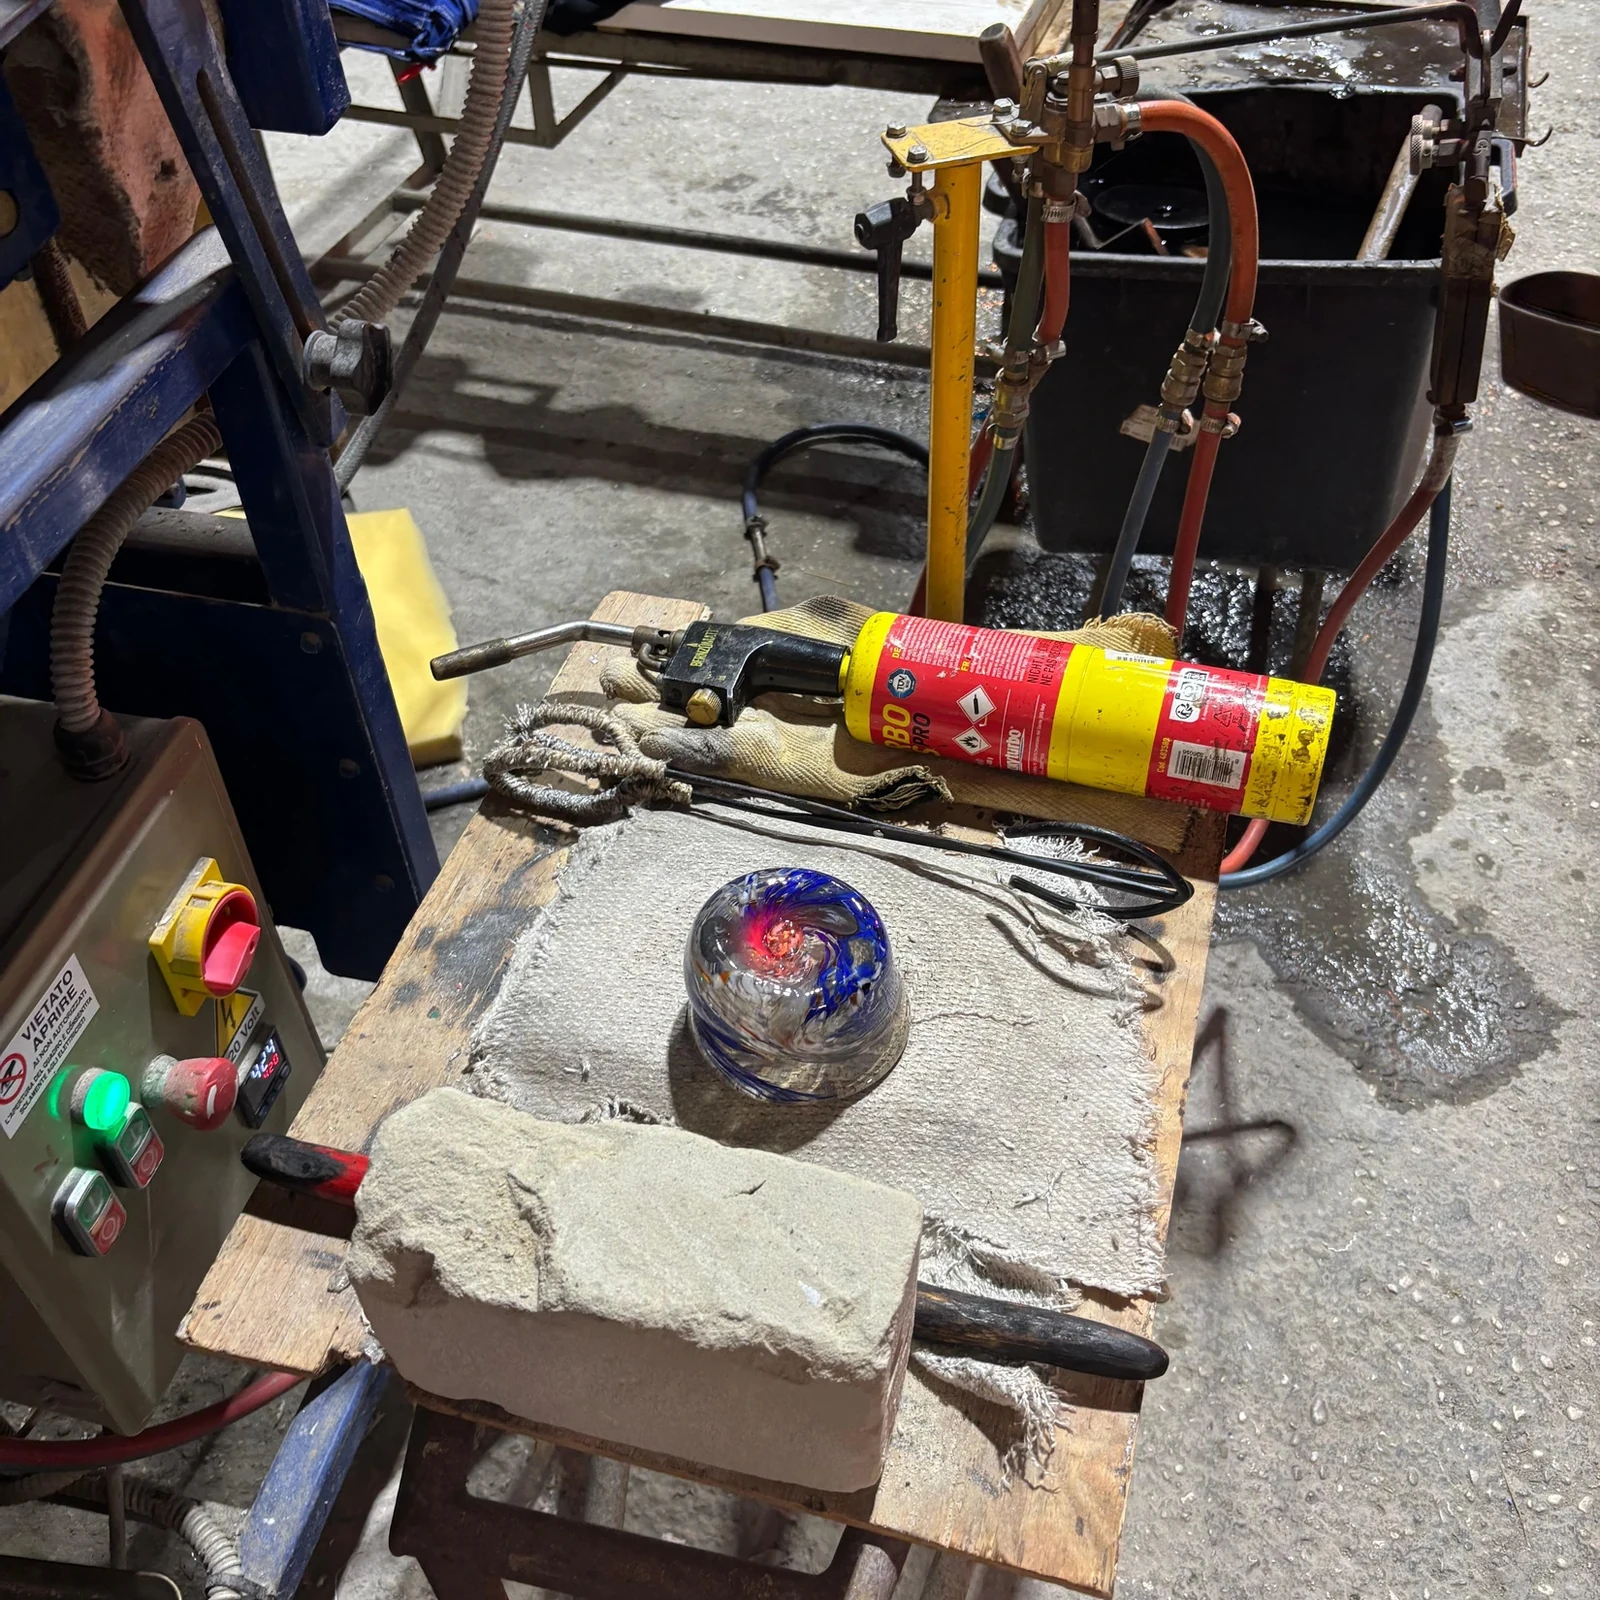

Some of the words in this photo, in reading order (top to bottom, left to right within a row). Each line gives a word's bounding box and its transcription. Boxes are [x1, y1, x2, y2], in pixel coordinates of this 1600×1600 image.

[892, 645, 901, 659] DE
[961, 660, 970, 671] FR
[1026, 659, 1042, 683] NICHT
[1043, 658, 1057, 673] PAS
[1040, 673, 1052, 686] NE
[912, 712, 930, 748] PRO
[22, 970, 72, 1042] VIETATO
[33, 984, 78, 1052] APRIRE
[33, 1058, 40, 1070] AI
[38, 1042, 52, 1062] NON
[53, 989, 86, 1039] AUTORIZZATI
[228, 1040, 240, 1060] 20
[241, 1006, 260, 1037] Volt
[20, 1074, 48, 1115] SOLAMENTE
[48, 1058, 59, 1076] AGLI
[58, 1016, 86, 1060] ELETTRICISTI
[250, 1038, 275, 1079] 424
[5, 1083, 34, 1125] L'APERTURA
[34, 1068, 44, 1084] DEL
[42, 1041, 62, 1068] QUADRO
